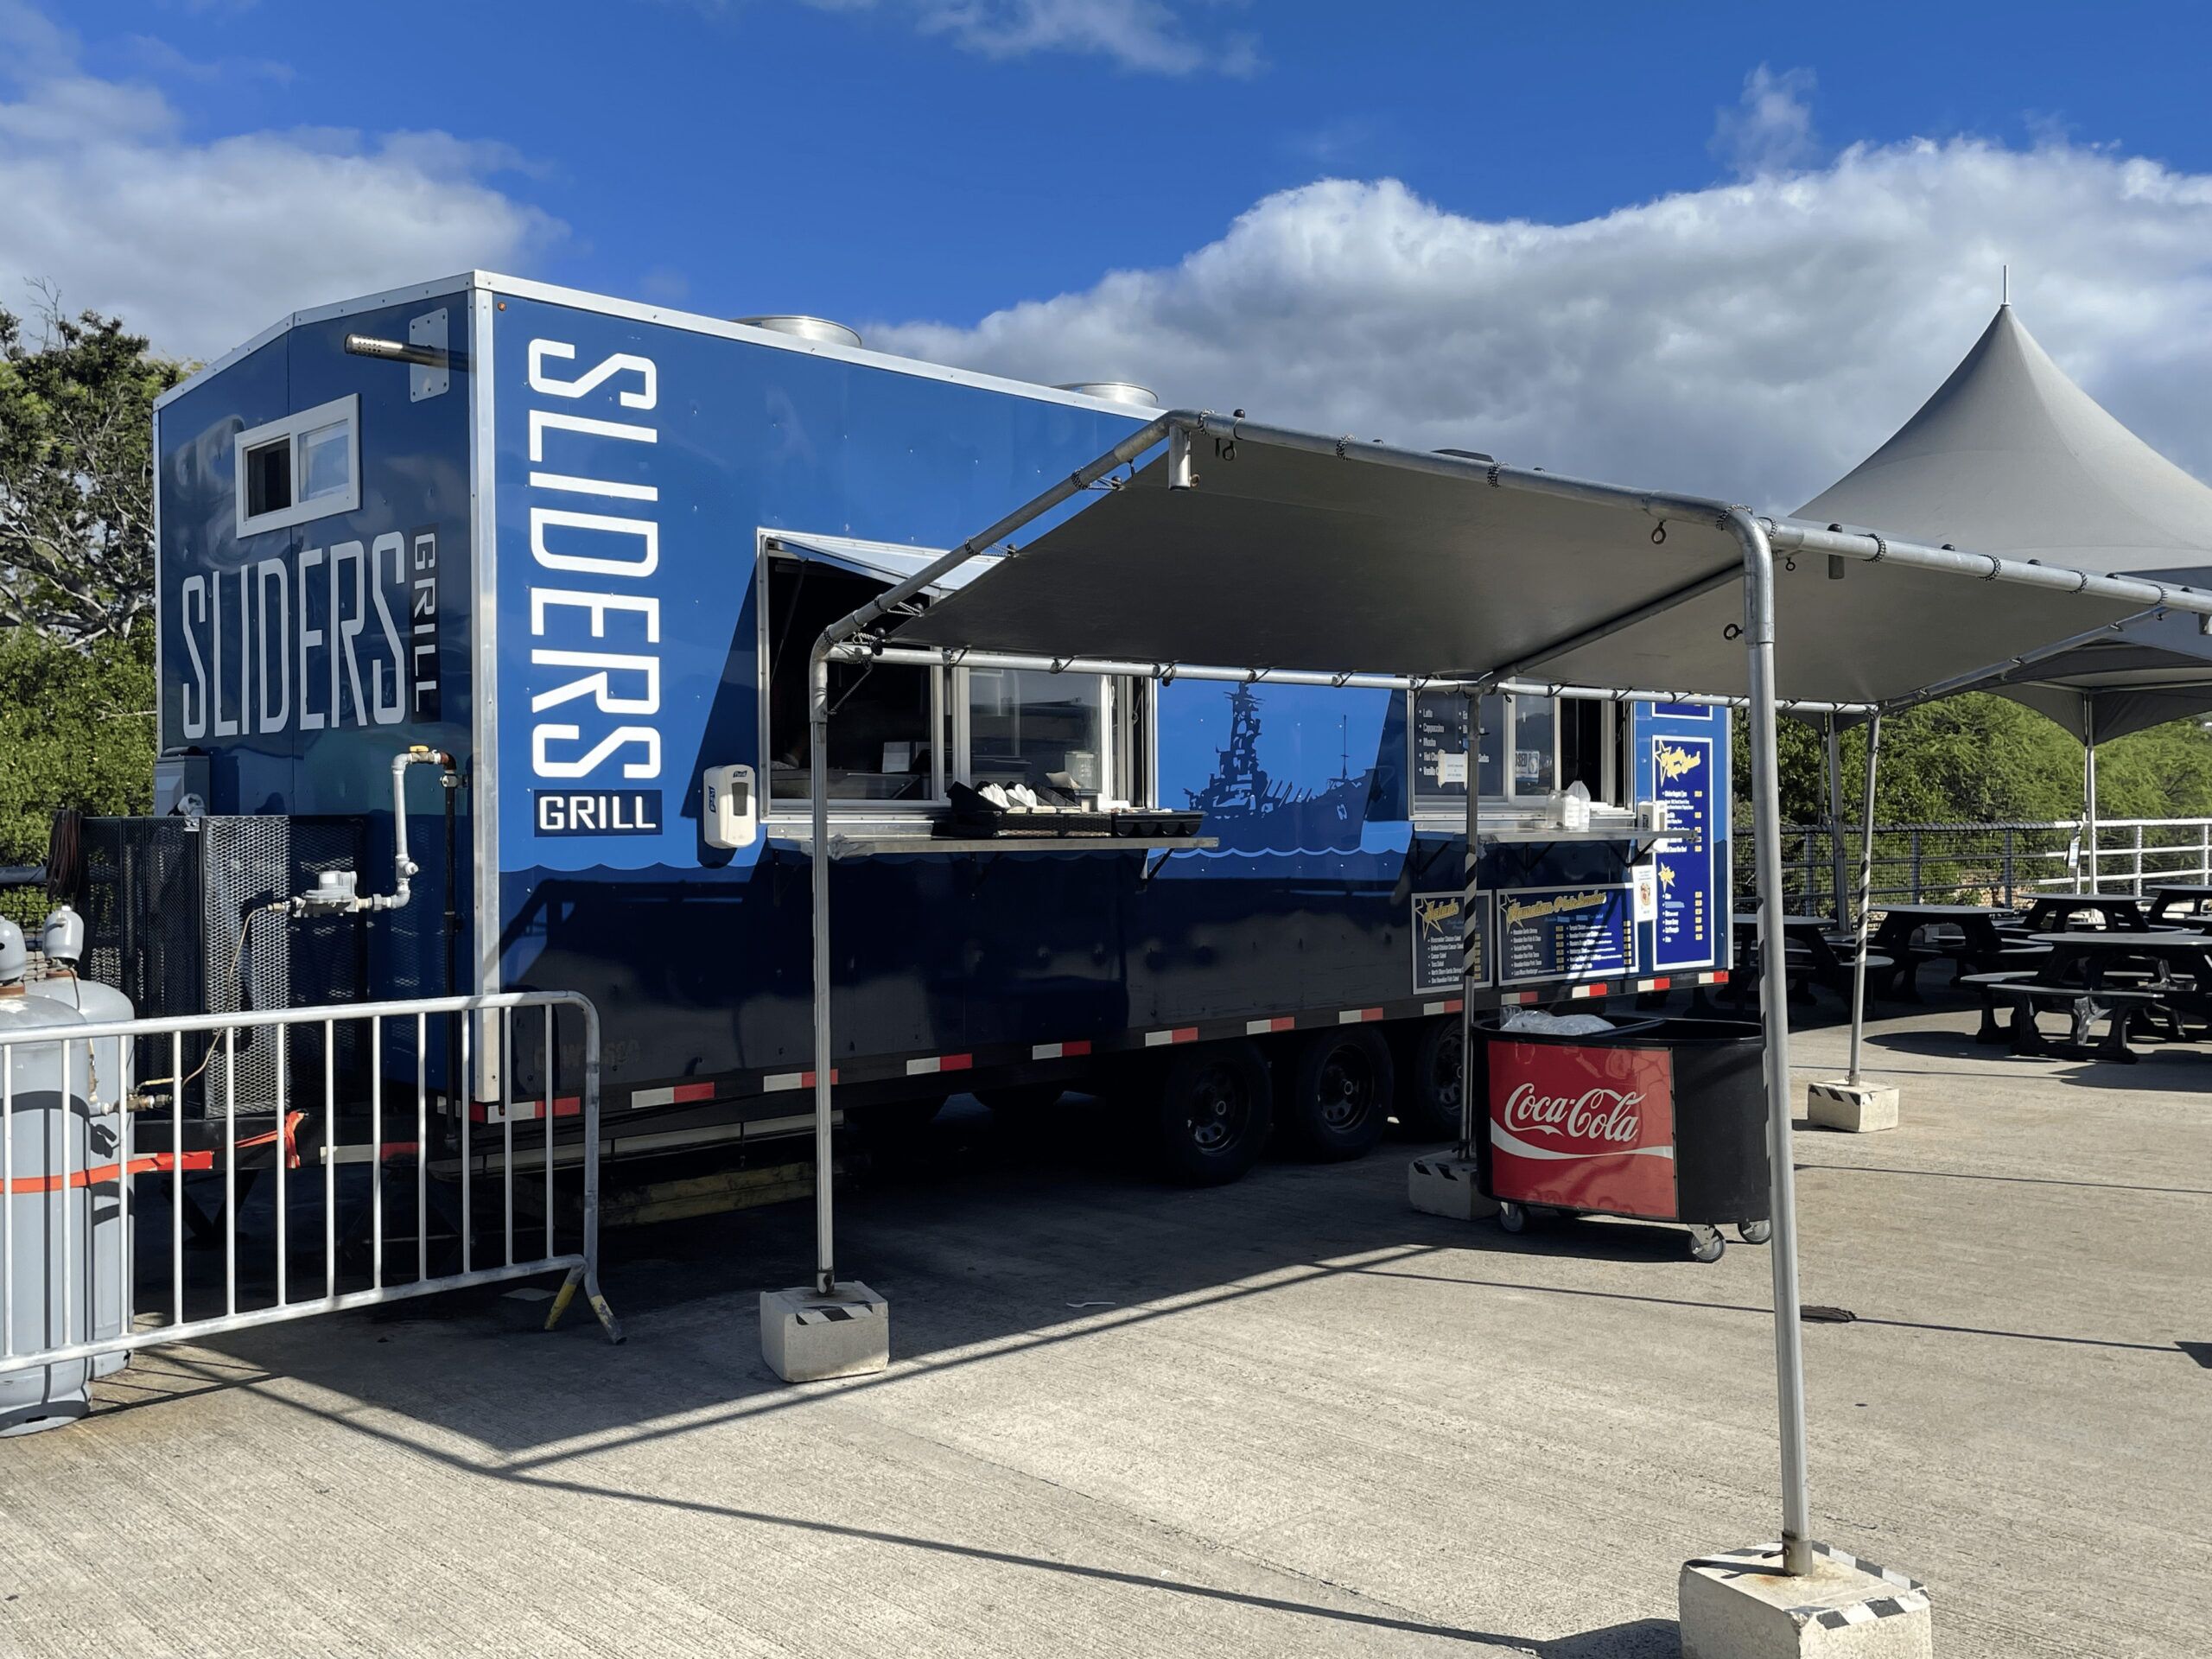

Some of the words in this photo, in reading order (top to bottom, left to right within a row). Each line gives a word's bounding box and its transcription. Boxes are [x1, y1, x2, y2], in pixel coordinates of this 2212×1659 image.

[181, 530, 406, 740] SLIDERS
[414, 532, 437, 714] GRILL
[528, 338, 662, 779] SLIDERS
[538, 795, 657, 830] GRILL
[1504, 1082, 1646, 1142] Coca-Cola
